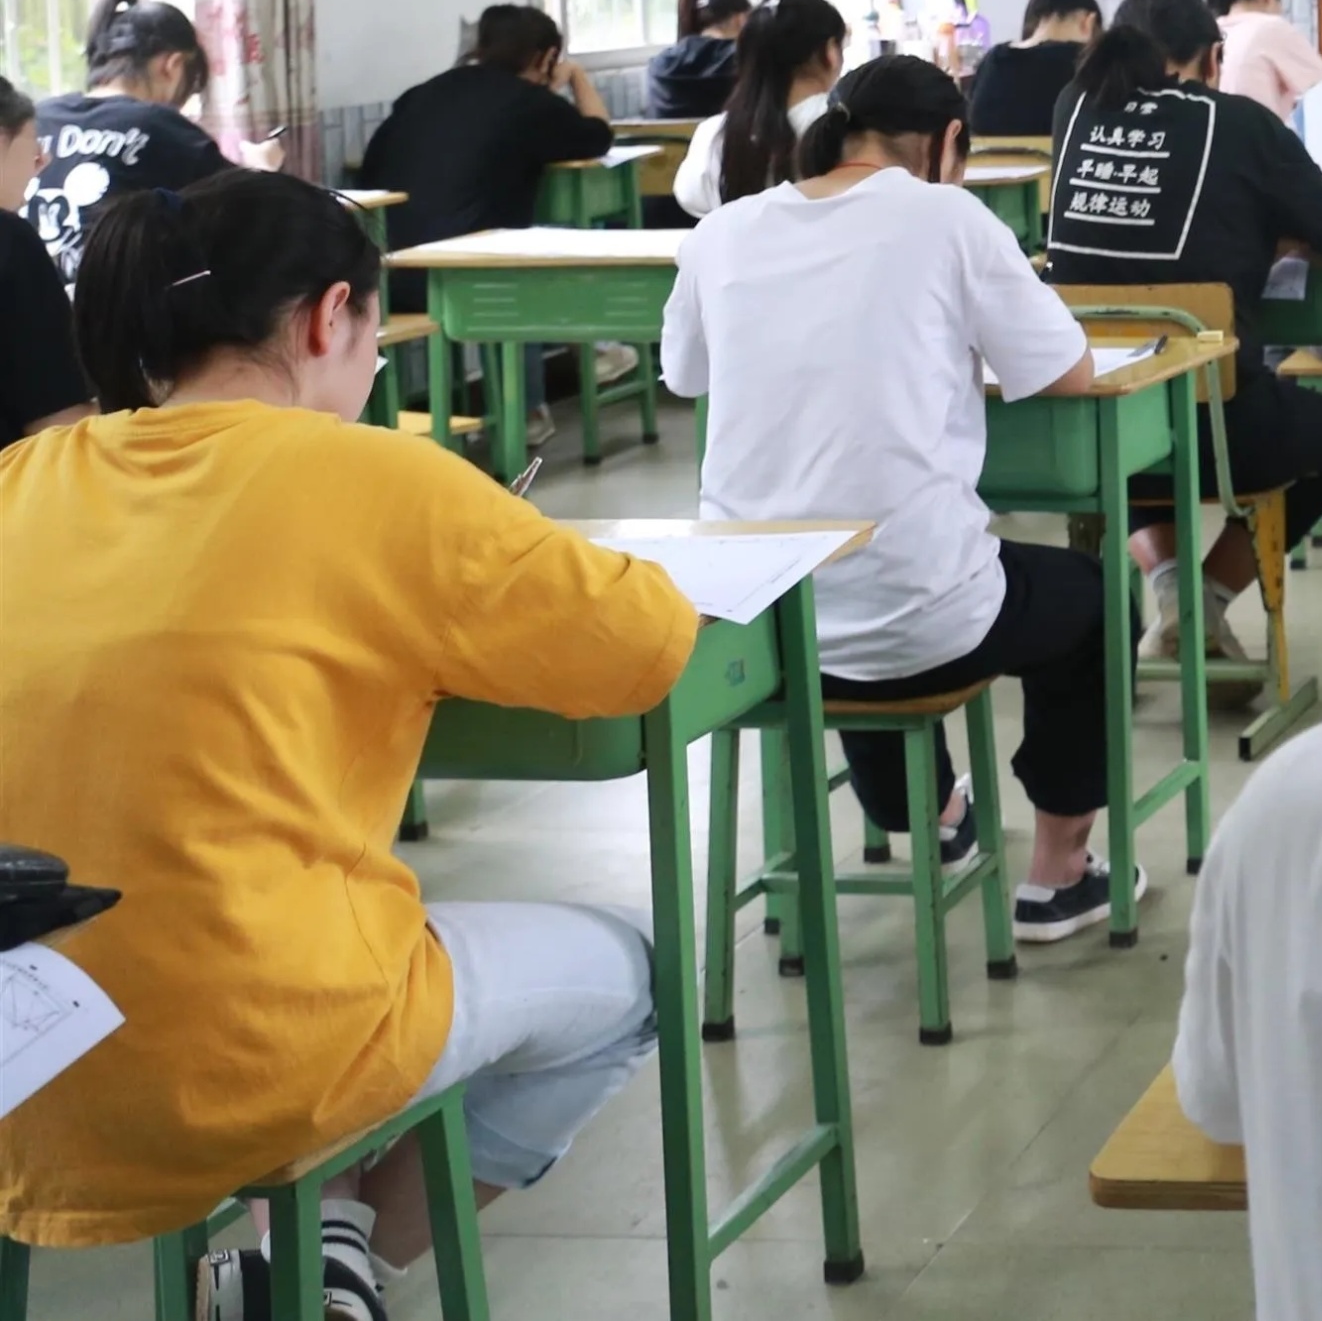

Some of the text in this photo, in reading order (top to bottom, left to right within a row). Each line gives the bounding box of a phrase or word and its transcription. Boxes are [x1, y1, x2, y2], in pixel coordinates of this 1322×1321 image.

[1089, 125, 1166, 150] 认真学习
[1069, 191, 1151, 218] 规律运动
